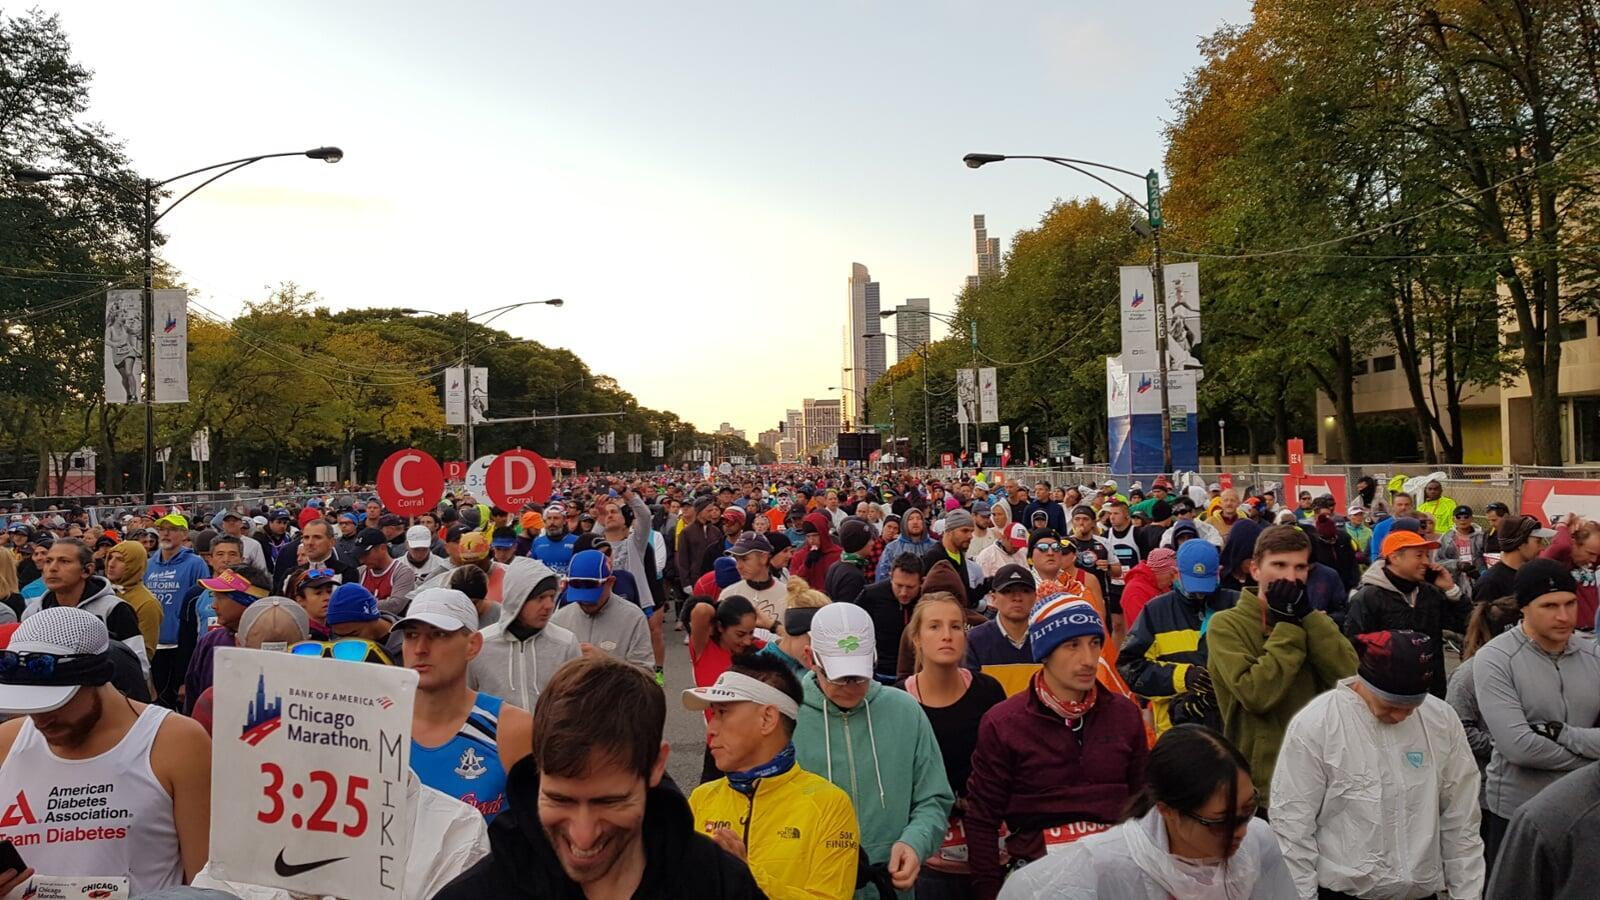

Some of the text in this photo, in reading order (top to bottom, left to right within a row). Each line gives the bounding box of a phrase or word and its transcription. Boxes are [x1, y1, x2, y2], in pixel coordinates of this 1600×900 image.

[1149, 177, 1160, 220] C240
[393, 454, 424, 497] C
[450, 463, 460, 476] D
[503, 455, 537, 496] D
[397, 497, 425, 508] Corral
[506, 495, 534, 505] Corral
[289, 687, 374, 707] BANK OF AMERICA
[288, 703, 355, 729] Chicago
[288, 724, 369, 751] Marathon
[48, 783, 114, 798] American
[47, 796, 107, 810] Diabetes
[257, 762, 369, 838] 3:25
[44, 807, 129, 823] Association
[378, 729, 402, 891] MIKE
[46, 826, 127, 843] Diabetes
[81, 882, 119, 894] CHICAGO
